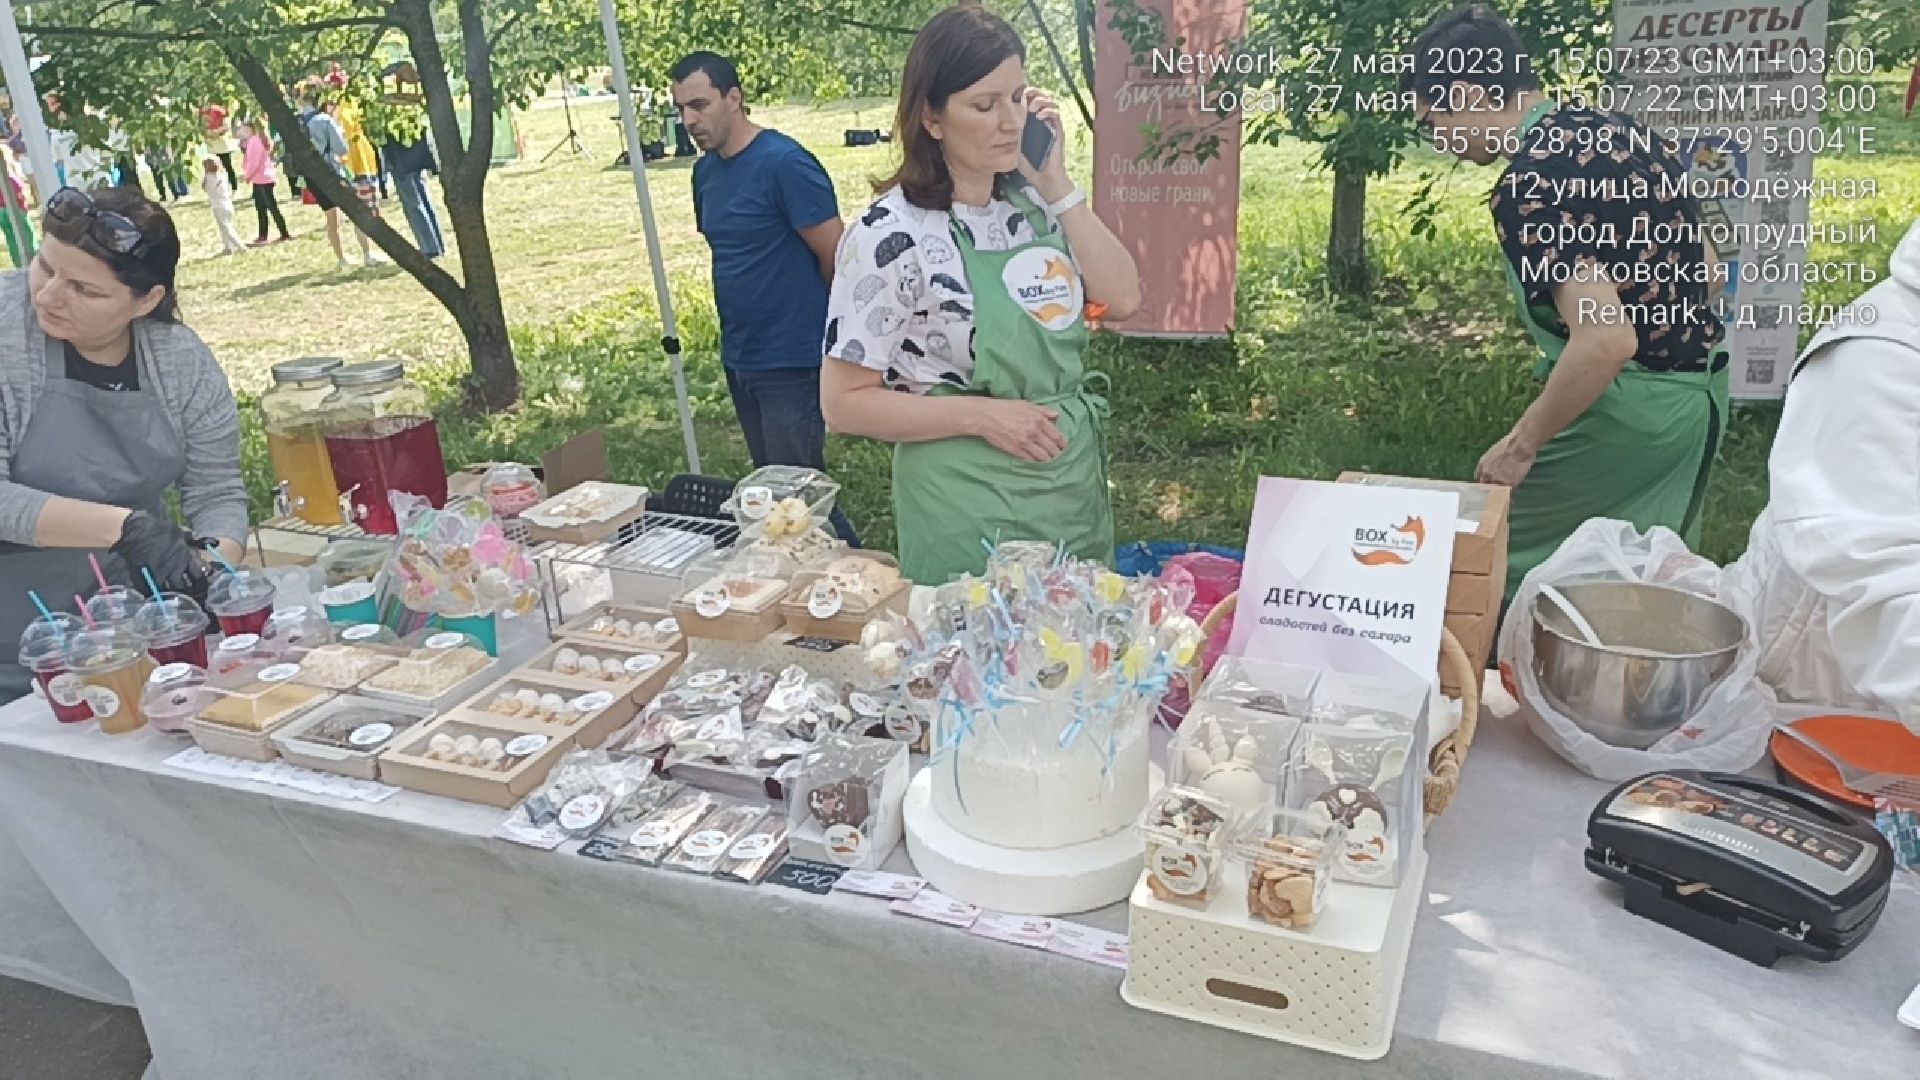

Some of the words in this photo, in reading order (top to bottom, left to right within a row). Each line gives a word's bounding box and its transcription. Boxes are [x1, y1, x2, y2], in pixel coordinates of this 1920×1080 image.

[1629, 6, 1806, 42] ДЕСЕРТЫ
[1110, 184, 1160, 203] новые
[1354, 527, 1388, 543] BOX
[1263, 587, 1416, 621] ДЕГУСТАЦИЯ
[1258, 616, 1328, 634] сладостей
[1331, 624, 1356, 637] без
[1359, 629, 1412, 646] сахара
[782, 869, 836, 889] 500
